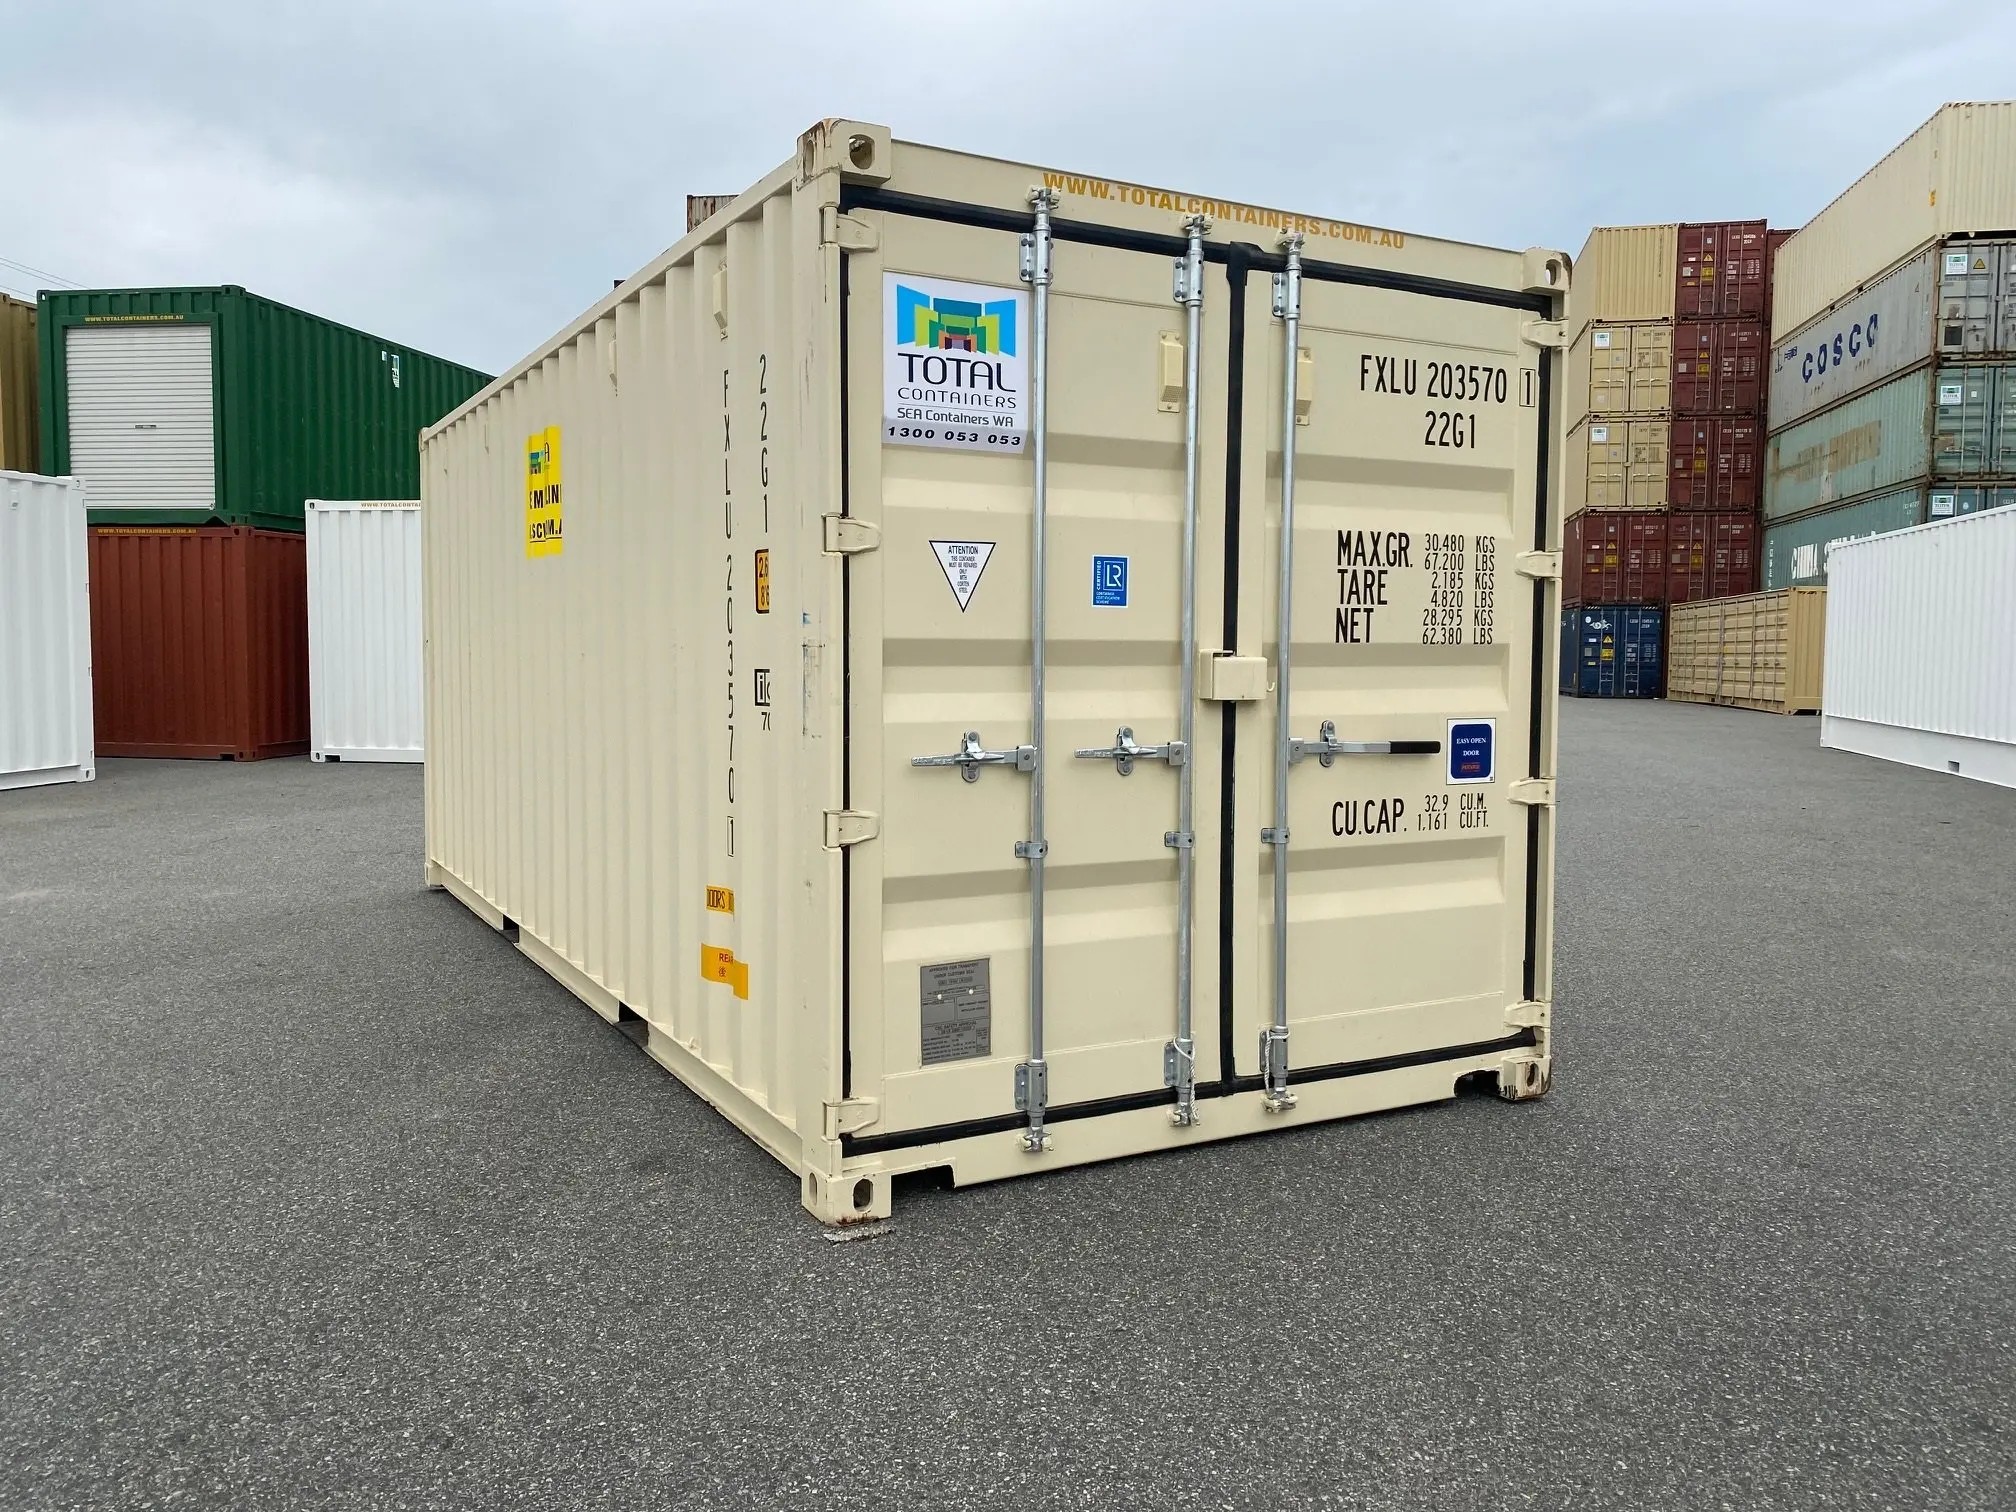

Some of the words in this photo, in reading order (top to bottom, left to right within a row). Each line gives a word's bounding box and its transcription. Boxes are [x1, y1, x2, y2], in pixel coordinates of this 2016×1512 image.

[1043, 172, 1404, 249] WWW.TOTALCONTAINERS.COM.AU
[898, 352, 1016, 393] TOTAL
[1361, 354, 1416, 395] FXLU
[1427, 362, 1507, 403] 203570
[898, 387, 1016, 409] CONTAINERS
[897, 407, 922, 420] SEA
[926, 409, 989, 426] Containers
[993, 415, 1013, 427] WA
[1425, 410, 1475, 448] 22G1
[759, 353, 768, 533] 22G1
[888, 426, 935, 439] 1300
[944, 431, 979, 442] 053
[988, 434, 1021, 446] 053
[948, 546, 978, 554] ATTENTION
[1337, 530, 1413, 567] MAX.GR.
[1425, 533, 1464, 552] 30,480
[1476, 536, 1495, 553] KGS
[1425, 553, 1464, 570] 67,200
[1475, 554, 1495, 571] LBS
[1107, 565, 1121, 587] LR
[1337, 569, 1388, 605] TARE
[1431, 571, 1463, 589] 2,185
[1475, 573, 1494, 590] KGS
[1431, 590, 1463, 608] 4,820
[1474, 591, 1494, 608] LBS
[1335, 608, 1374, 643] NET
[1423, 609, 1462, 626] 28,295
[1474, 609, 1493, 626] KGS
[1422, 627, 1462, 645] 62,380
[1473, 627, 1493, 645] LBS
[1424, 794, 1449, 812] 32.9
[1460, 793, 1487, 810] CU.M.
[1332, 798, 1407, 836] CU.CAP.
[1418, 813, 1447, 831] 1,161
[1460, 810, 1489, 829] CU.FT.
